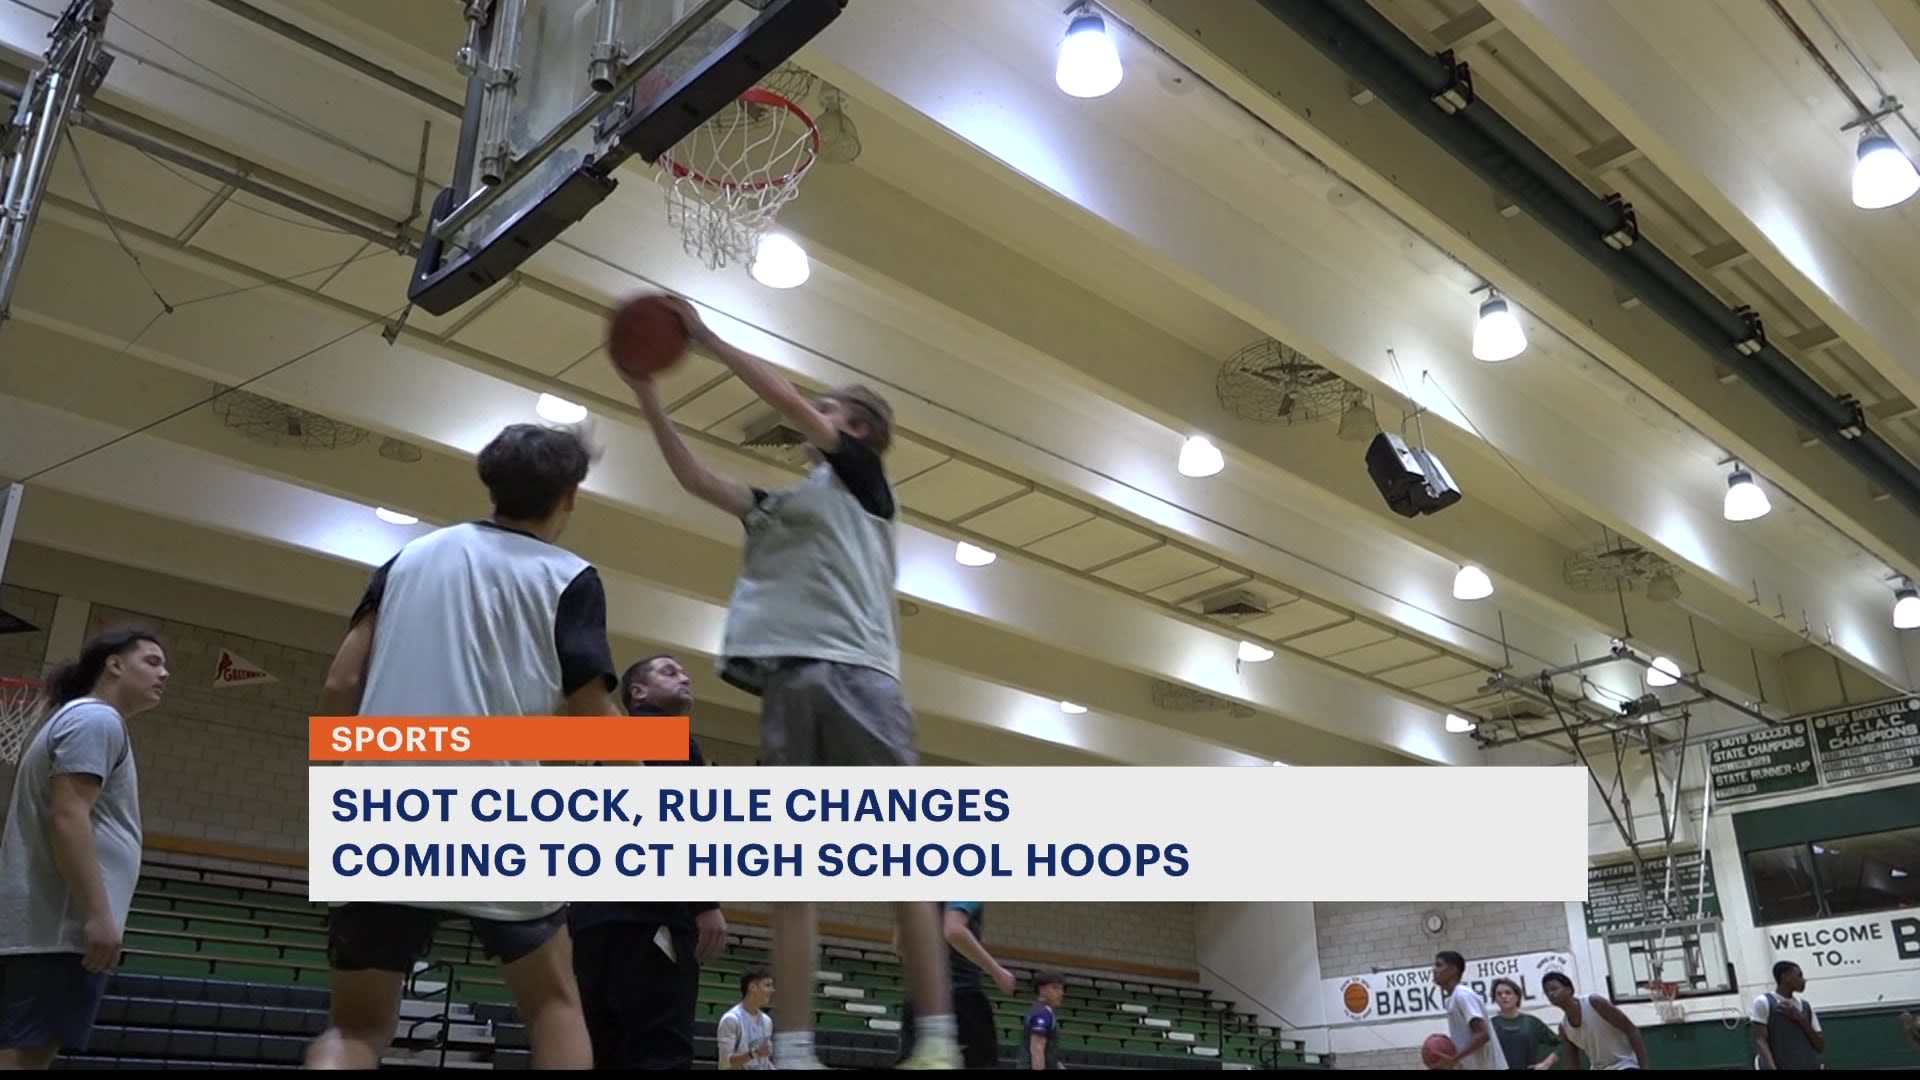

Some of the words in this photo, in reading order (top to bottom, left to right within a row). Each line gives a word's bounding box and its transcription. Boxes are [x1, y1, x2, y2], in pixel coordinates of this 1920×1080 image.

[1713, 747, 1746, 763] STATE
[1747, 736, 1806, 756] CHAMPIONS
[1828, 723, 1919, 750] CHAMPIONS
[1715, 771, 1749, 787] STATE
[1750, 760, 1811, 781] RUNNER-UP
[1770, 923, 1882, 950] WELCOME
[1812, 950, 1861, 967] TO...
[1386, 970, 1434, 989] NORW
[1477, 959, 1519, 978] HIGH
